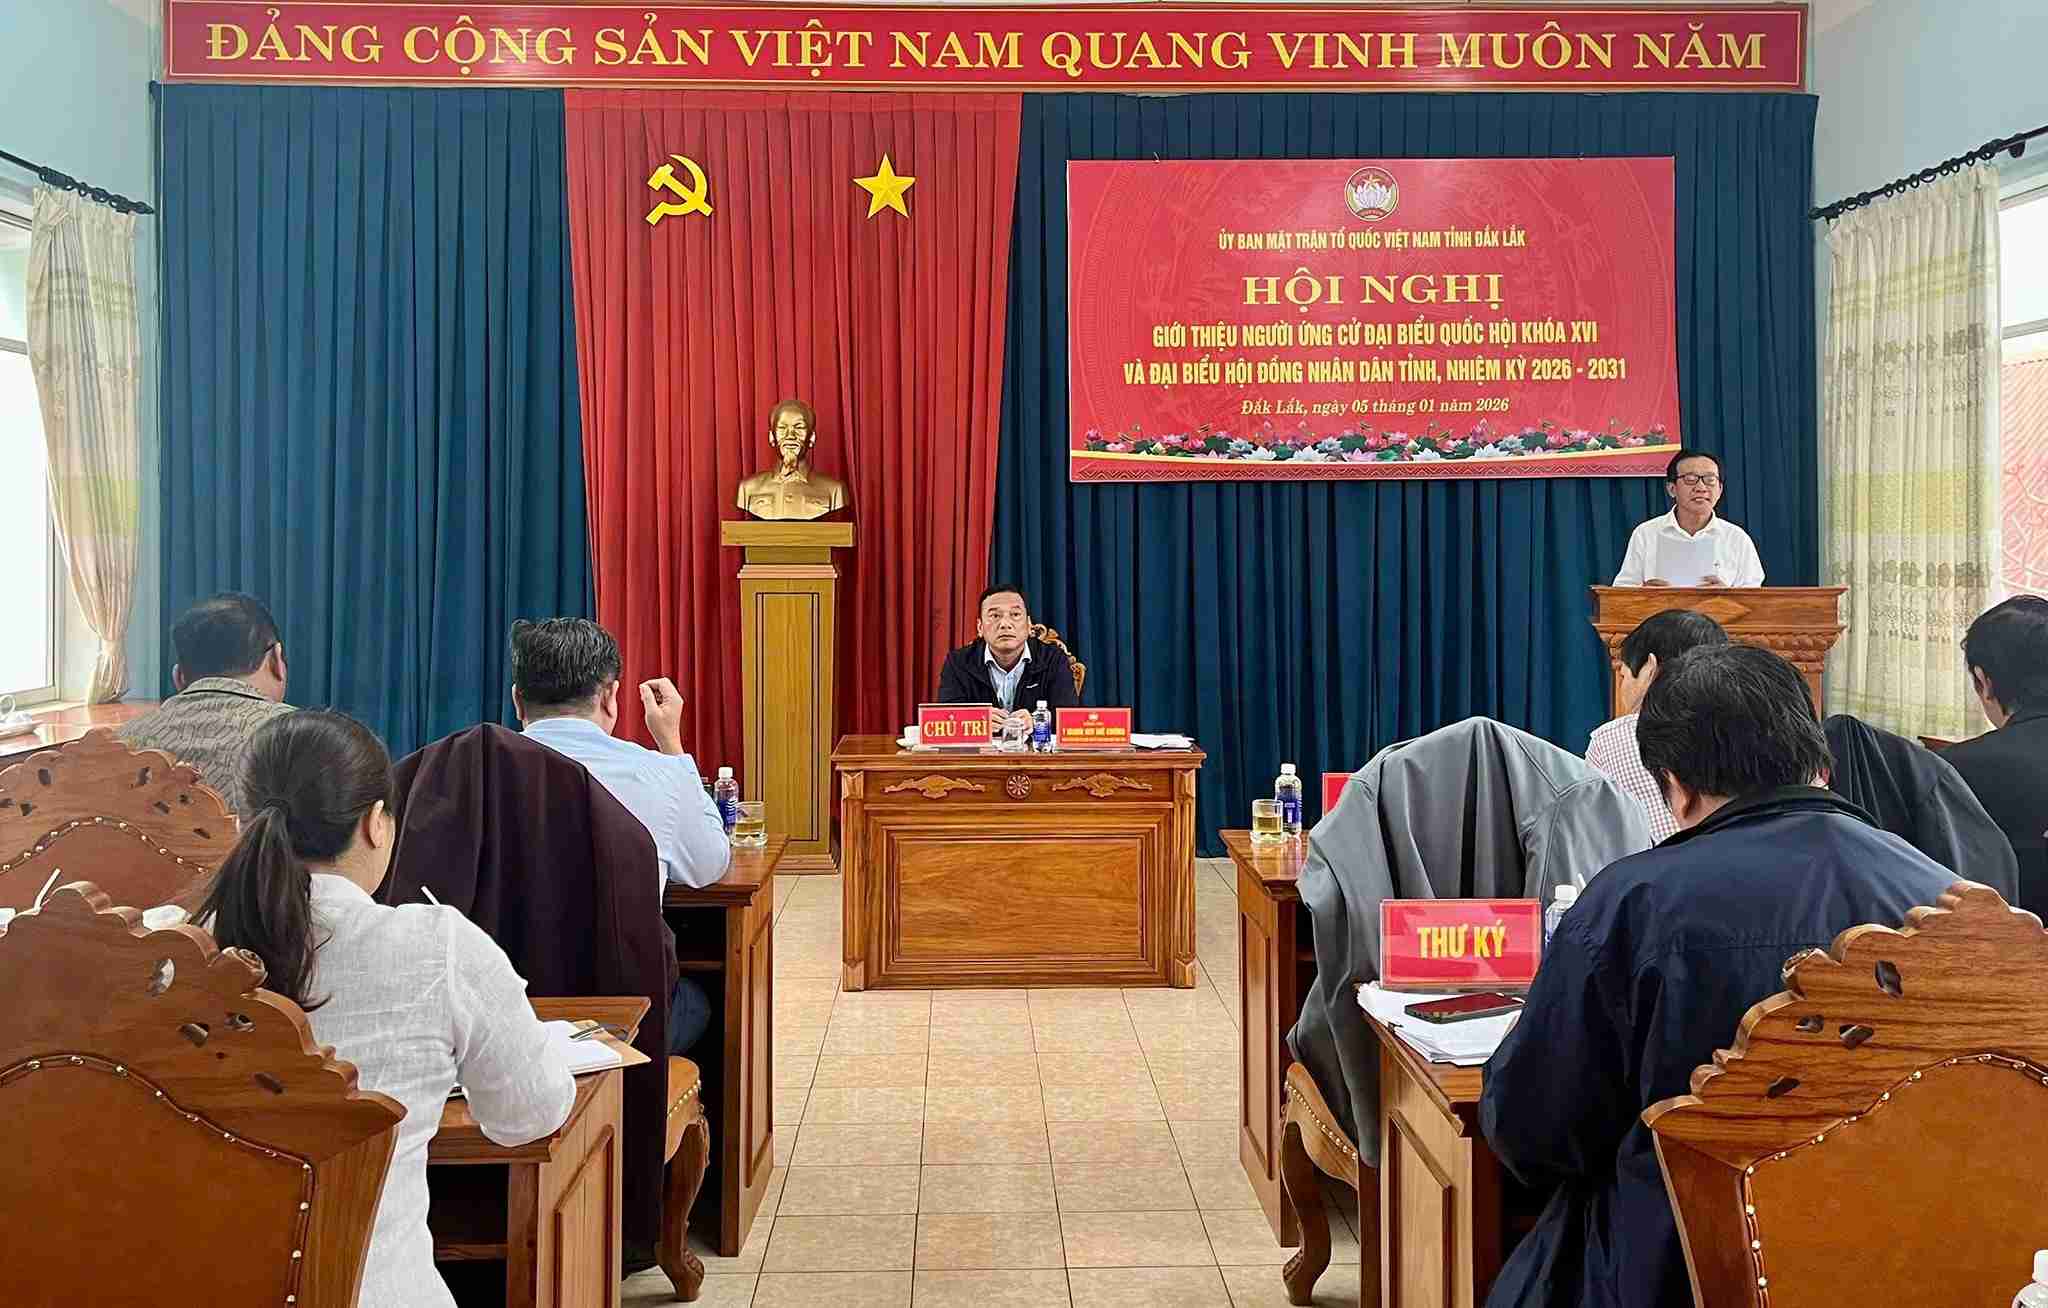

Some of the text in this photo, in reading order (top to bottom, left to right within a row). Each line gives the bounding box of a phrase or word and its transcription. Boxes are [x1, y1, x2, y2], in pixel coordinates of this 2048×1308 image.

[206, 8, 1767, 78] ĐẢNG CỘNG SẢN VIỆT NAM QUANG VINH MUÔN NĂM
[1219, 225, 1526, 252] ỦY BAN MẶT TRẬN TỔ QUỐC VIỆT NAM TỈNH ĐẮK LẮK
[1243, 267, 1504, 312] HỘI NGHỊ
[1153, 315, 1597, 351] GIỚI THIỆU NGƯỜI ỨNG CỬ ĐẠI BIỂU QUỐC HỘI KHÓA XVI
[1124, 359, 1145, 384] VÀ
[1150, 363, 1177, 388] ĐẠI
[1183, 354, 1220, 384] BIỂU
[1225, 359, 1252, 388] HỘI
[1257, 355, 1303, 384] ĐỒNG
[1308, 357, 1354, 383] NHÂN
[1360, 357, 1393, 383] DÂN
[1398, 353, 1441, 384] TỈNH,
[1447, 355, 1500, 386] NHIỆM
[1506, 355, 1526, 380] KỲ
[1532, 359, 1571, 380] 2026
[1588, 358, 1626, 379] 2031
[1241, 398, 1509, 416] Đắk Lắk, ngày 05 tháng 01 năm 2026
[924, 714, 988, 736] CHỦ TRÌ
[1418, 919, 1506, 958] THƯ KÝ
